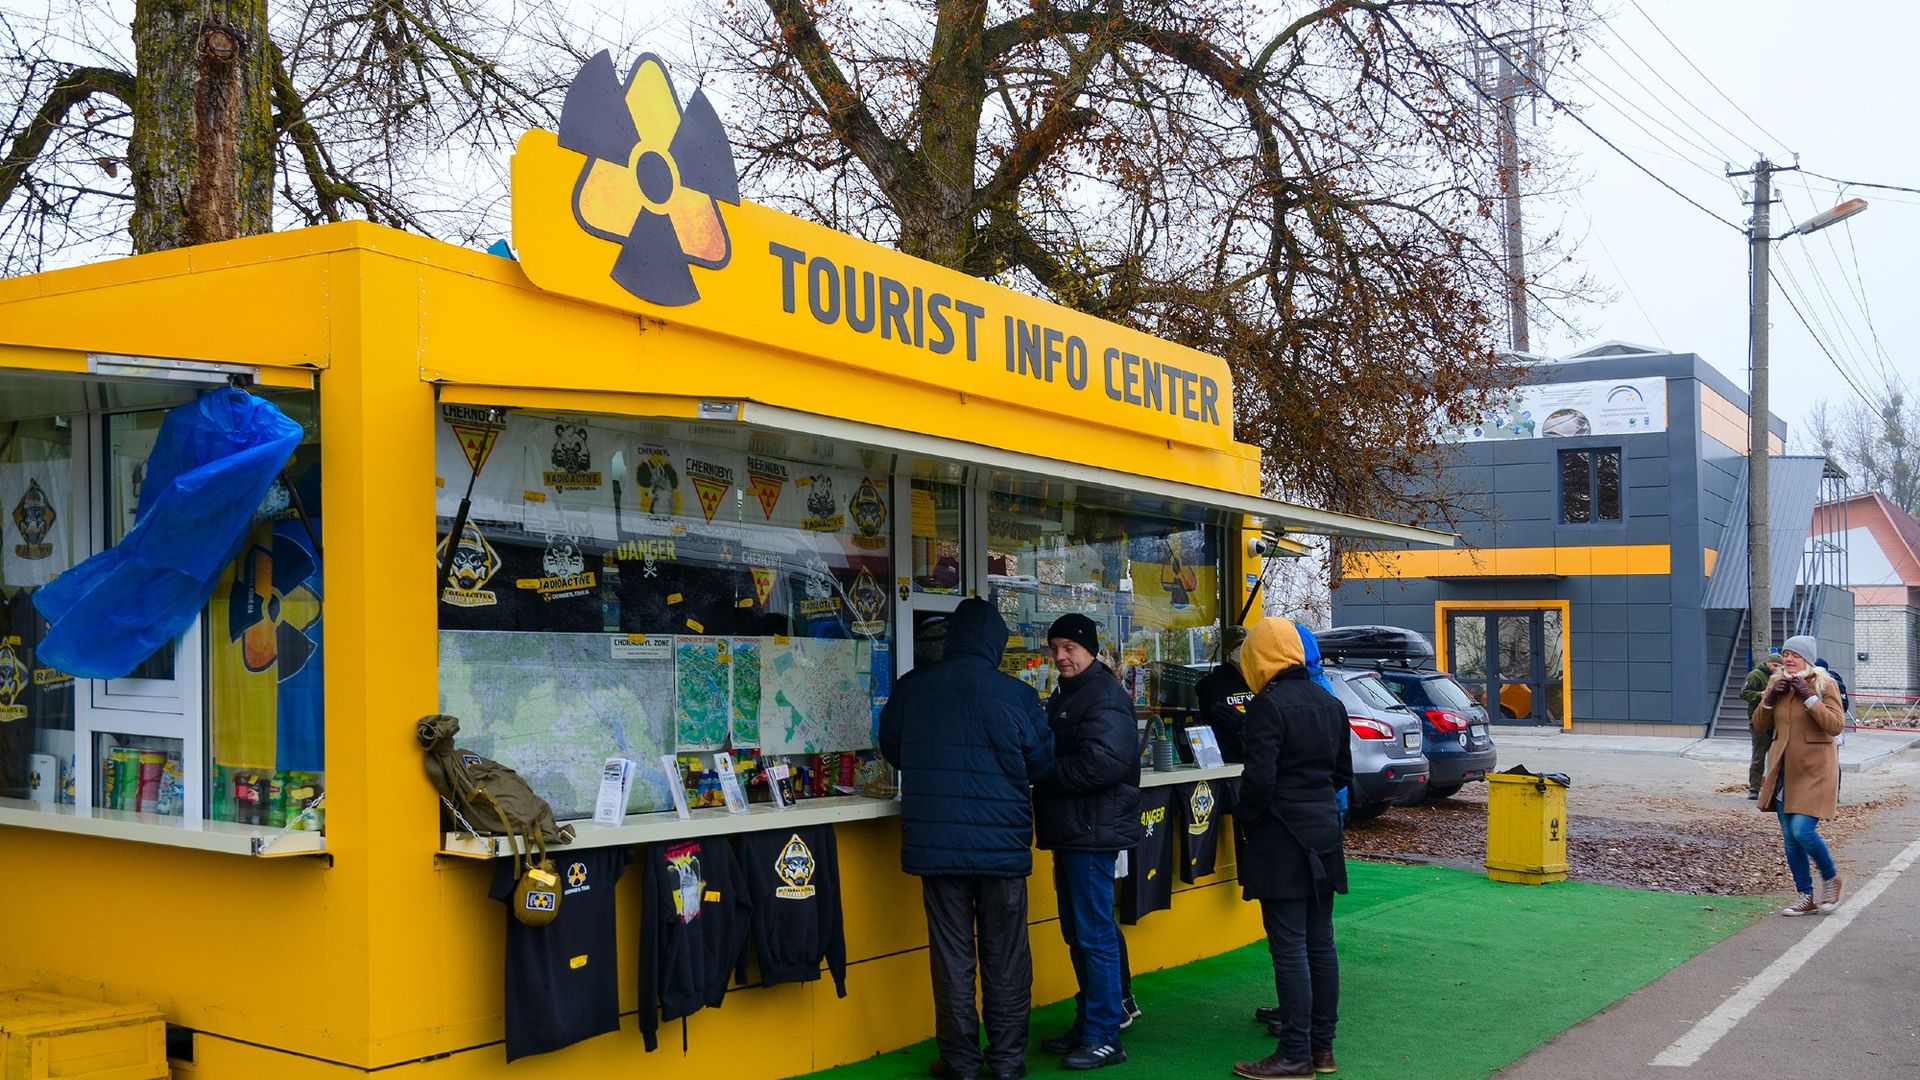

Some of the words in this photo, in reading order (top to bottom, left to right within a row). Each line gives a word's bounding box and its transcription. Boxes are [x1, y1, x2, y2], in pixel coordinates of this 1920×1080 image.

[769, 241, 985, 362] TOURIST
[1005, 315, 1088, 391] INFO
[1104, 347, 1220, 426] CENTER
[443, 404, 507, 424] CHERNOYL
[686, 457, 734, 481] CHERNOBYL
[616, 539, 677, 561] DANGER
[654, 639, 670, 647] ZONE
[1140, 805, 1166, 827] ANGER
